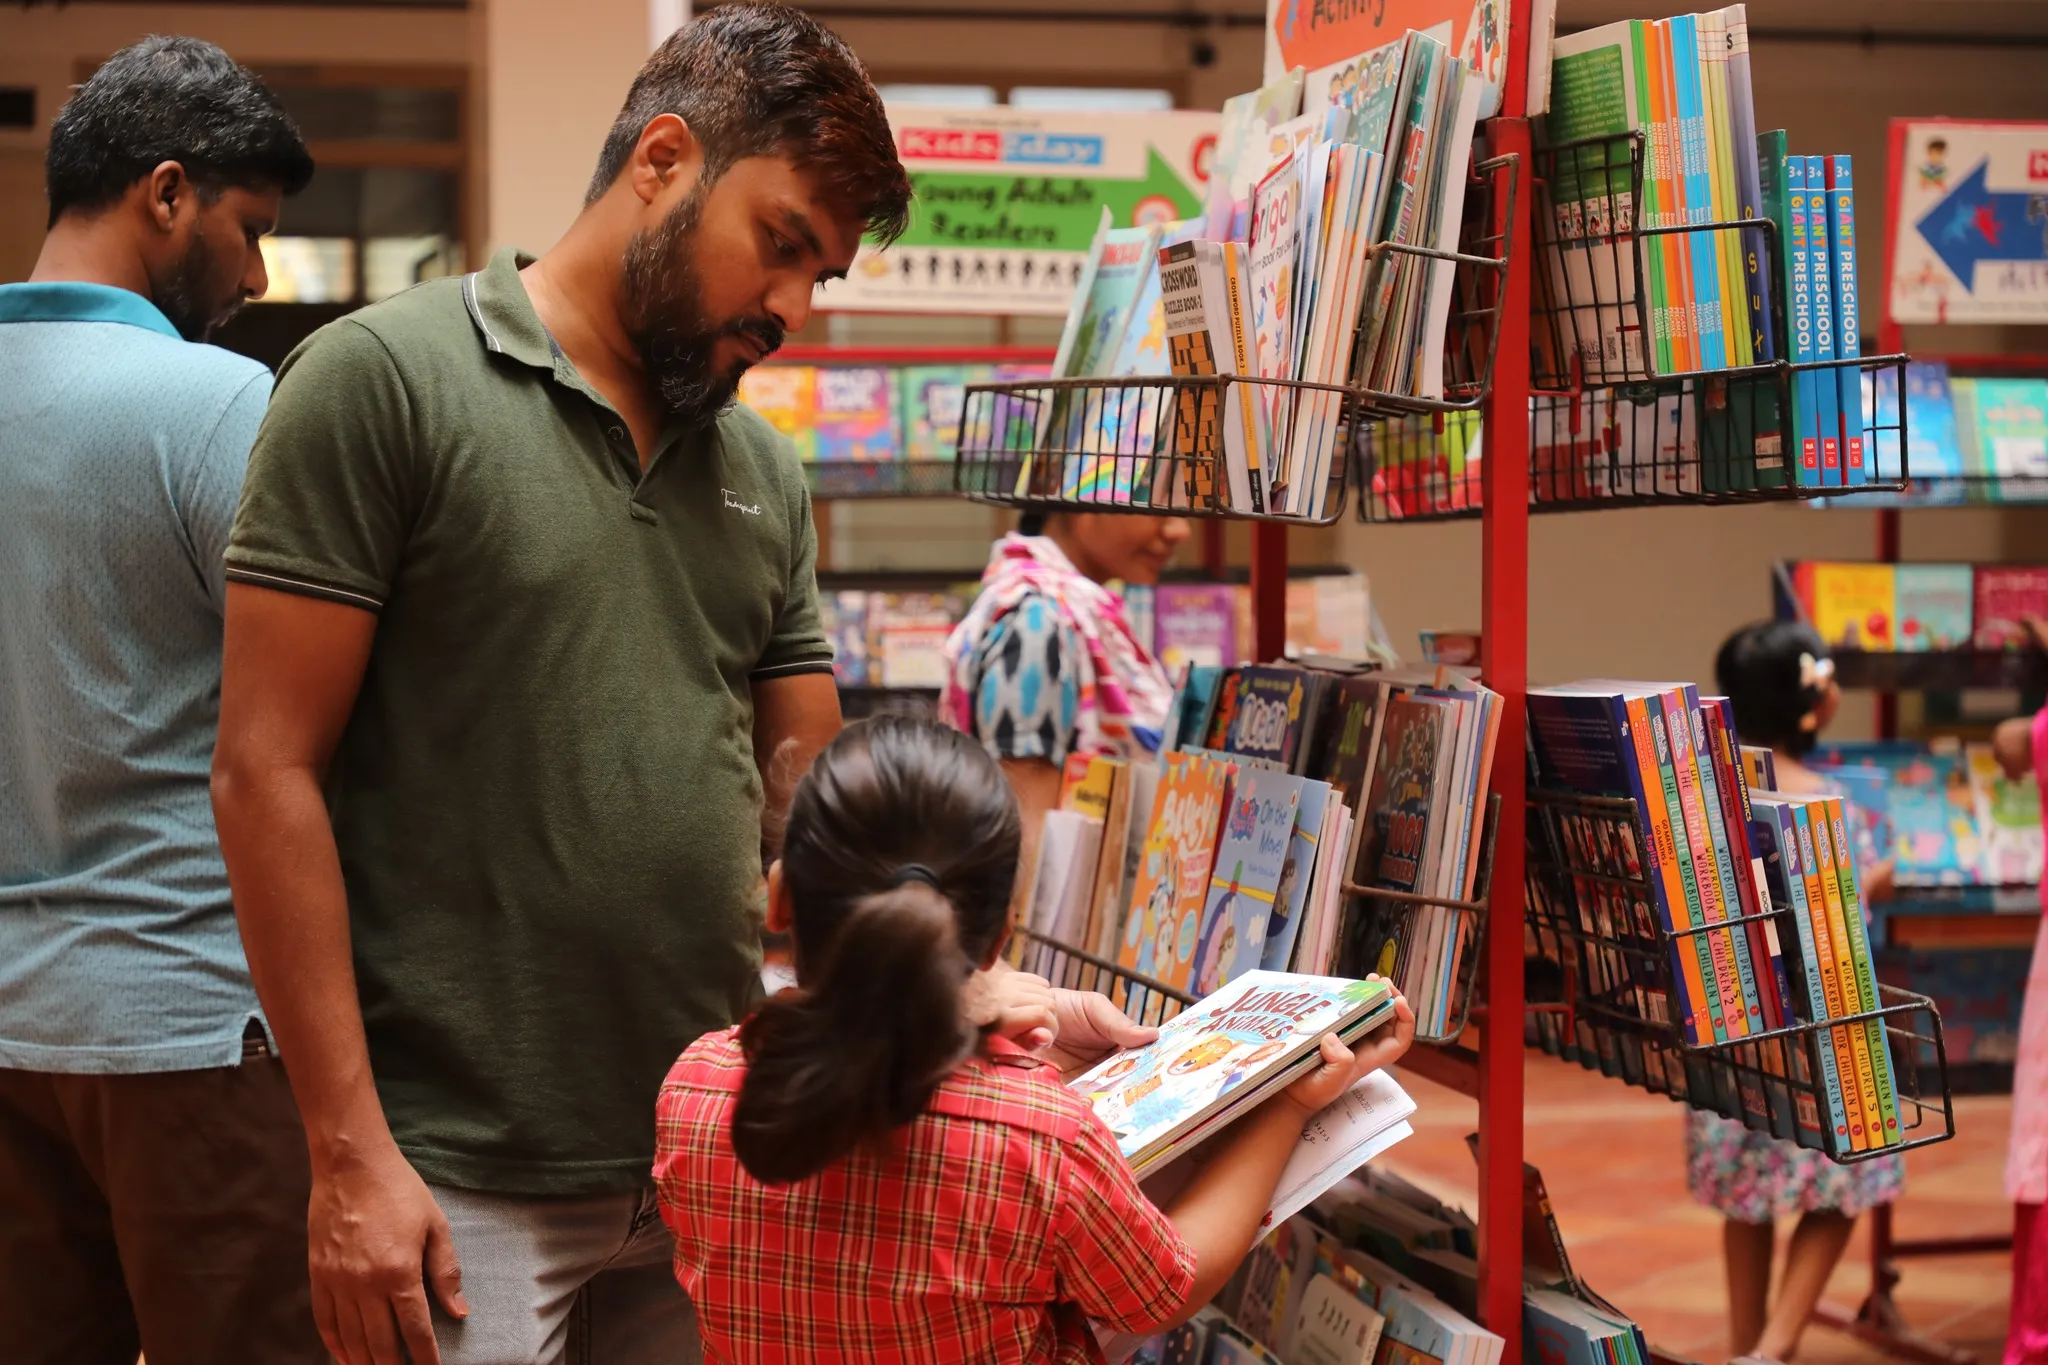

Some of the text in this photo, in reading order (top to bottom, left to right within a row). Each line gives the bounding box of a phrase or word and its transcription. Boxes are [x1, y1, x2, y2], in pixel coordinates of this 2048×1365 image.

[903, 130, 999, 157] Kids
[1788, 166, 1803, 179] 3+
[1808, 166, 1823, 179] 3+
[1836, 165, 1850, 178] 3+
[1161, 264, 1198, 294] CROSSWORD
[1791, 196, 1811, 356] GIANT PRESCHOOL
[1811, 196, 1831, 355] GIANT PRESCHOOL
[1838, 195, 1857, 355] GIANT PRESCHOOL
[1230, 277, 1240, 316] CROSSWORD
[1235, 316, 1243, 344] PUZZLES
[1664, 774, 1677, 796] THE
[1680, 769, 1693, 789] THE
[1701, 763, 1714, 784] THE
[1710, 718, 1734, 820] Building Vocabulary Skills
[1736, 764, 1752, 822] MATHEMATICS
[1662, 820, 1668, 830] GO
[1669, 801, 1689, 855] ULTIMATE
[1685, 795, 1705, 849] ULTIMATE
[1707, 789, 1727, 842] ULTIMATE
[1646, 834, 1659, 869] English
[1656, 836, 1667, 860] MATHS
[1663, 831, 1673, 855] MATHS
[1736, 856, 1746, 876] Book
[1681, 859, 1701, 918] WORKBOOK
[1689, 763, 1699, 783] THE
[1722, 935, 1738, 985] CHILDREN
[1696, 853, 1716, 912] WORKBOOK
[1718, 846, 1737, 904] WORKBOOK
[1793, 882, 1804, 902] THE
[1809, 883, 1822, 904] THE
[1826, 875, 1839, 897] THE
[1843, 877, 1856, 900] THE
[1694, 922, 1706, 942] FR
[1708, 916, 1721, 937] FR
[1797, 908, 1816, 962] ULTIMATE
[1813, 909, 1833, 963] ULTIMATE
[1830, 901, 1850, 955] ULTIMATE
[1847, 903, 1867, 957] ULTIMATE
[1699, 947, 1718, 998] CHILDREN
[1713, 942, 1731, 993] CHILDREN
[1735, 935, 1754, 986] CHILDREN
[1209, 985, 1332, 1023] JUNGLE
[1824, 967, 1842, 1019] WORKBOO
[1858, 961, 1877, 1011] WORKBOO
[1835, 1029, 1849, 1051] FOR
[1852, 1022, 1865, 1043] FOR
[1869, 1023, 1882, 1046] FOR
[1823, 1054, 1842, 1106] CHILDREN
[1839, 1055, 1858, 1106] CHILDREN
[1857, 1049, 1876, 1099] CHILDREN
[1874, 1051, 1892, 1101] CHILDREN
